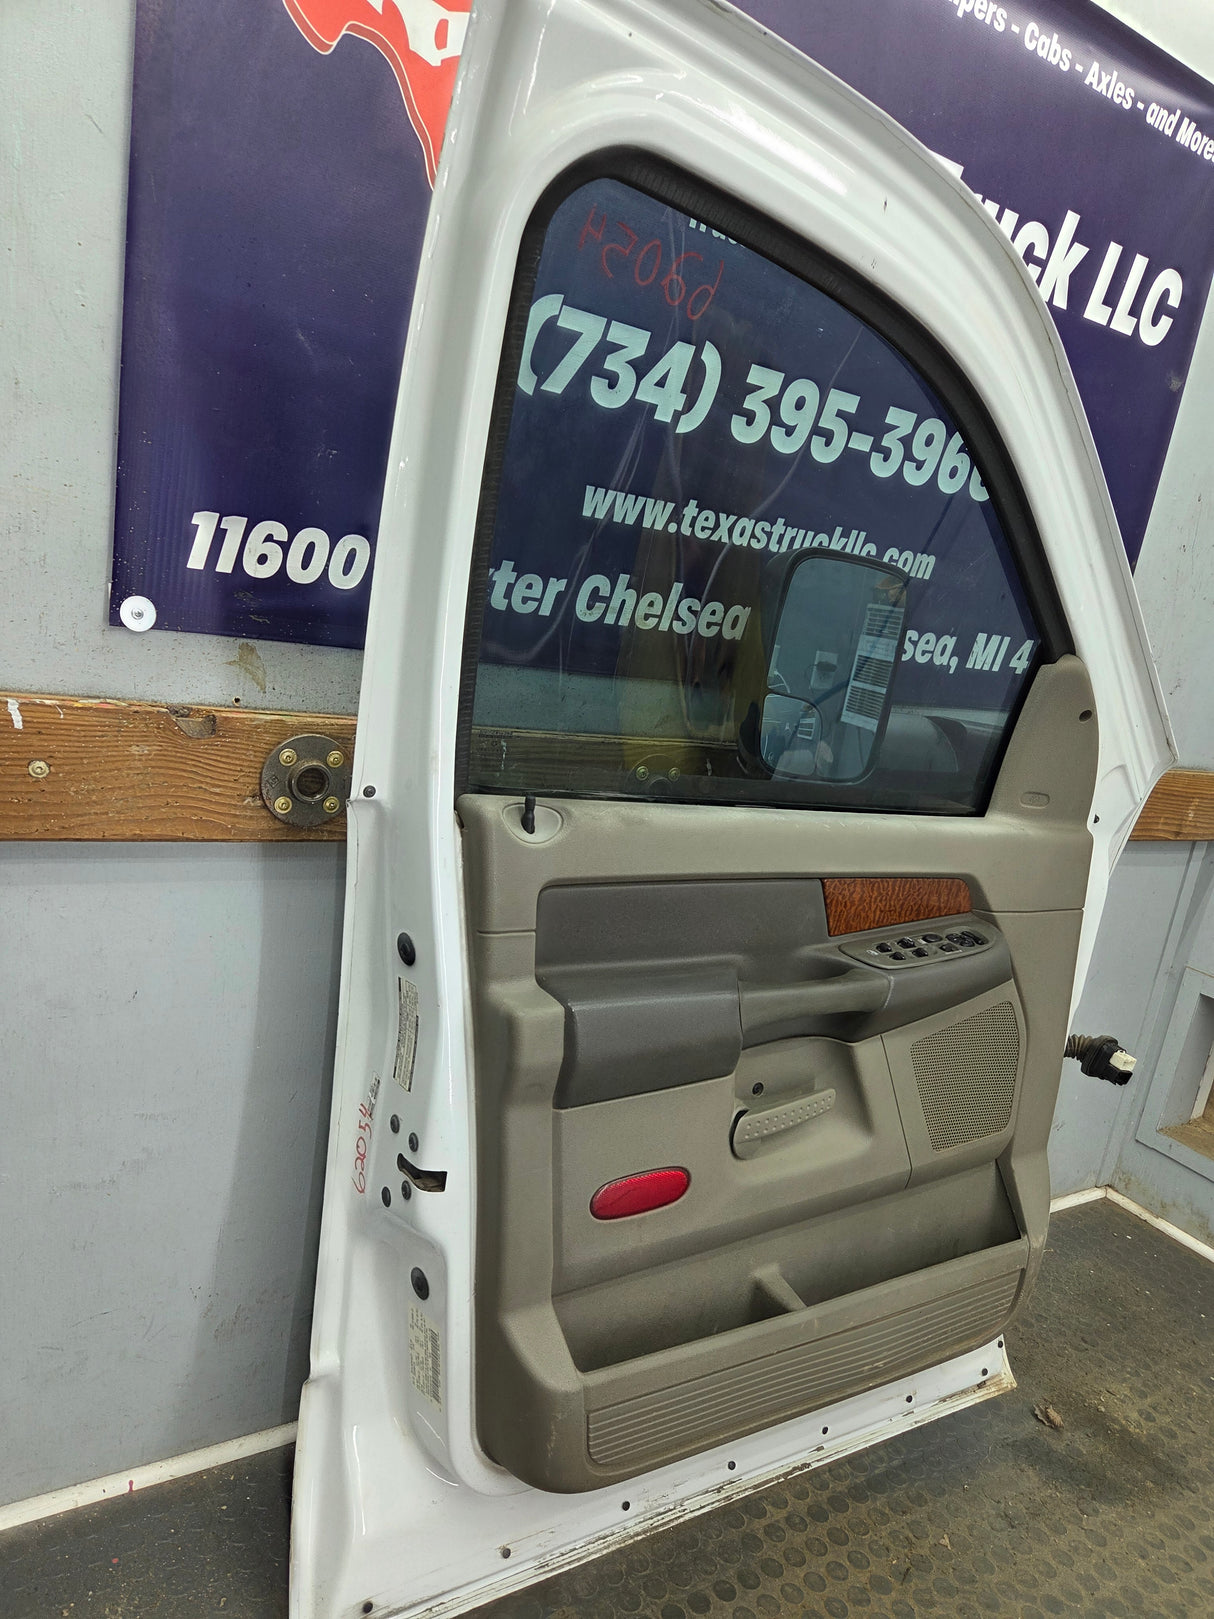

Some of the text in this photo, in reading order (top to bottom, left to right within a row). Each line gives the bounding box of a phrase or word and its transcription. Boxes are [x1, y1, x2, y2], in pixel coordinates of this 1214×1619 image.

[949, 0, 1008, 32] pers
[1024, 22, 1072, 71] Cabs
[1084, 61, 1135, 110] Axles
[1146, 102, 1181, 137] and
[1176, 116, 1214, 163] More
[1083, 241, 1183, 346] LLC
[517, 294, 722, 434] (734)
[186, 511, 371, 589] 11600
[489, 560, 567, 616] ter
[575, 573, 751, 641] Chelsea
[965, 632, 1011, 672] MI
[351, 1102, 373, 1194] 62054
